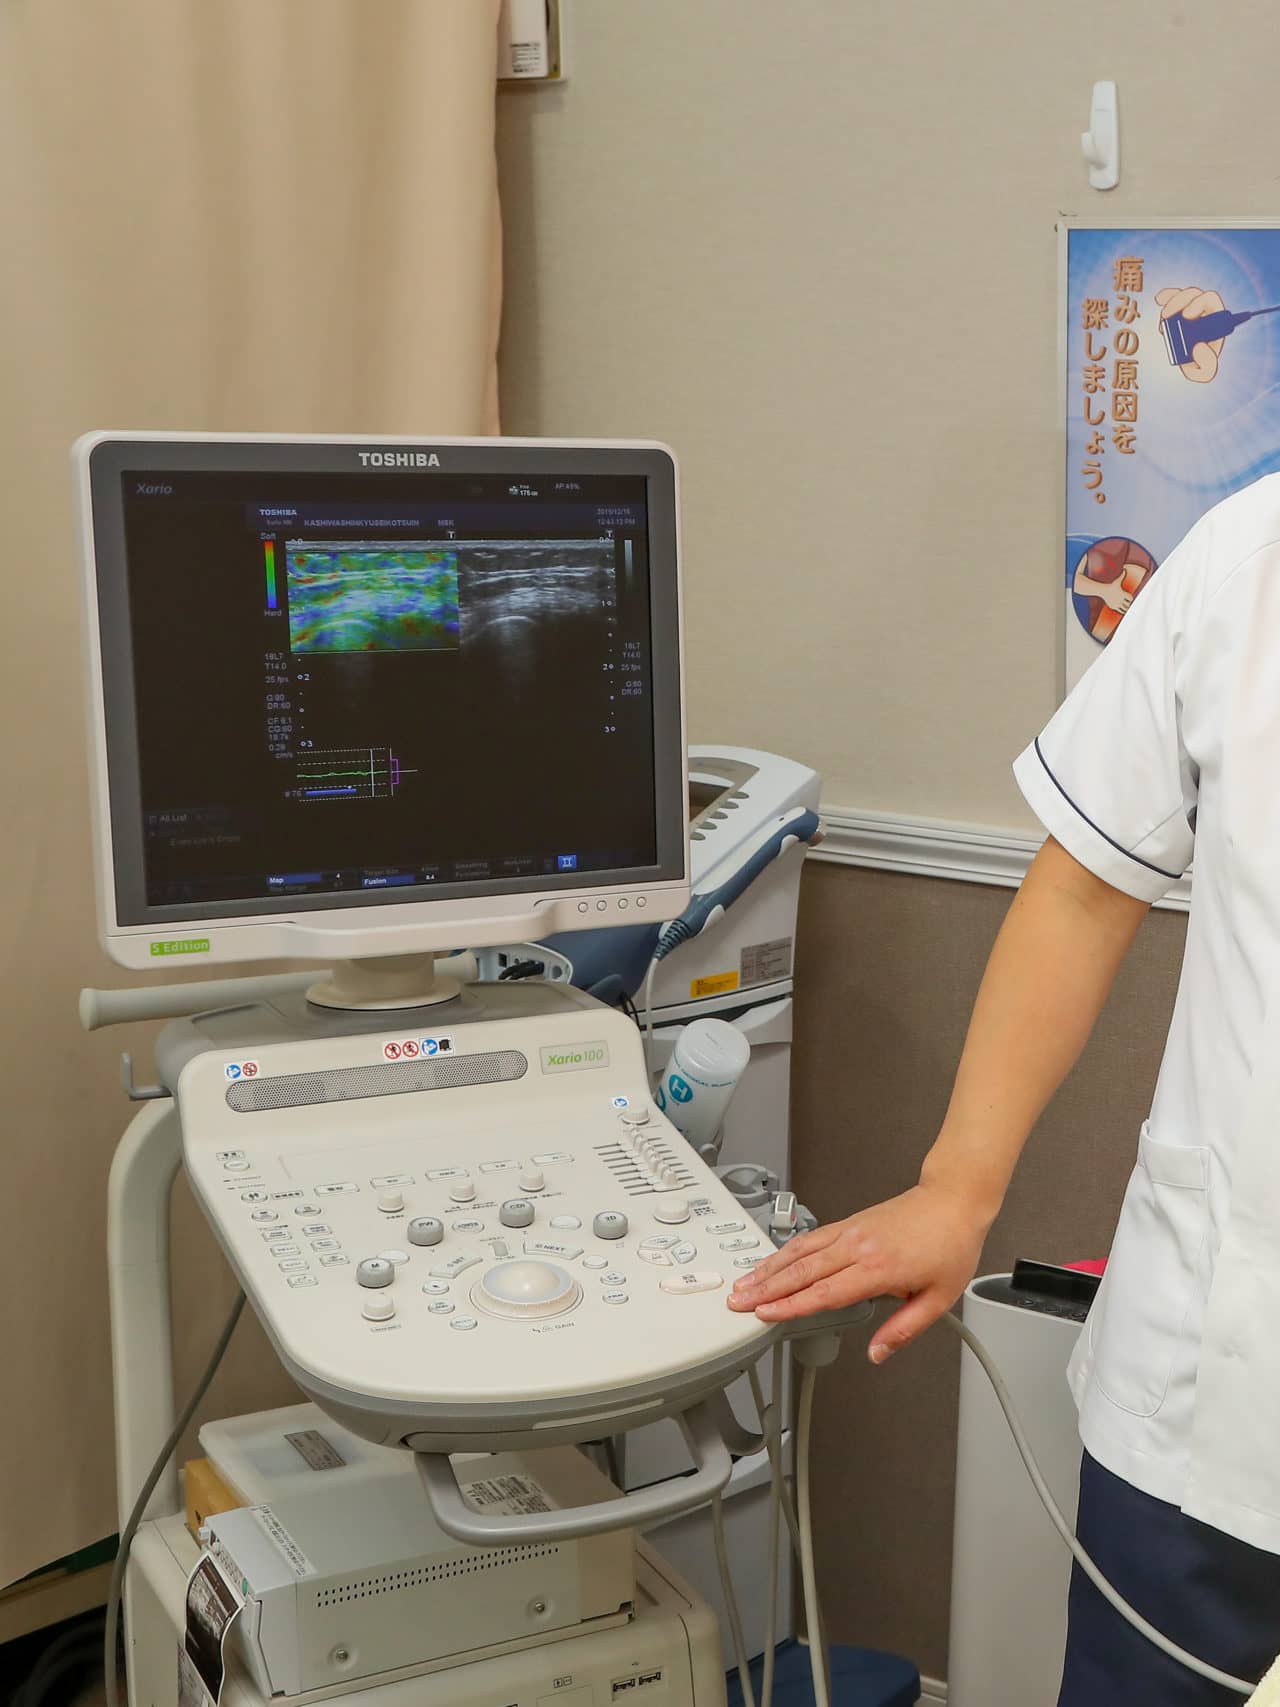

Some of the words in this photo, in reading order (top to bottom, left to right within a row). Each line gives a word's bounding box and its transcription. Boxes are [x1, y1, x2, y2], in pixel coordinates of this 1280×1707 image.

[1110, 255, 1144, 455] 痛みの原因を
[1080, 297, 1109, 505] 探しましょう。
[358, 452, 440, 467] TOSHIBA
[136, 482, 173, 495] Xario
[259, 508, 297, 516] TOSHIBA
[152, 943, 160, 953] S
[164, 941, 209, 953] Edition
